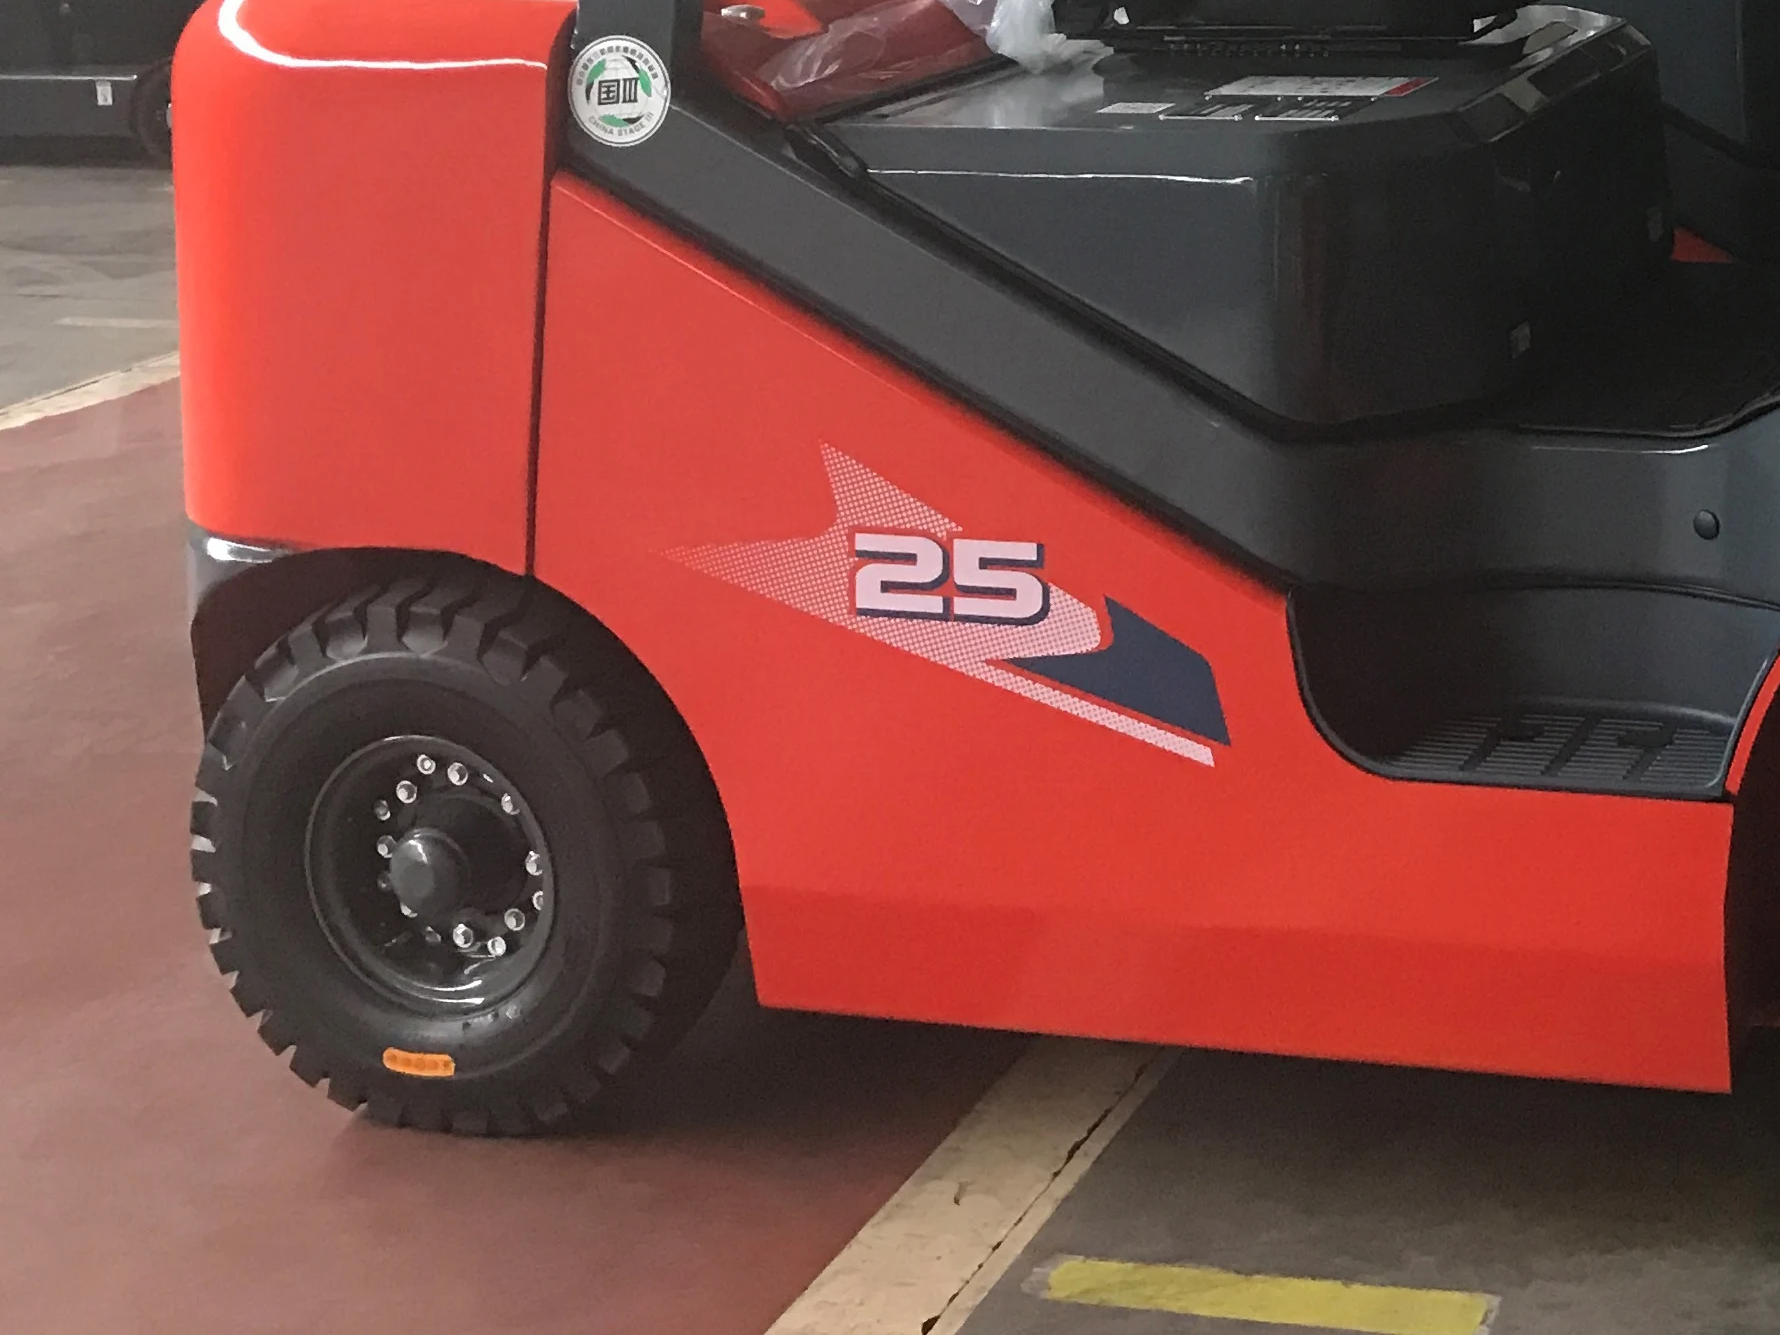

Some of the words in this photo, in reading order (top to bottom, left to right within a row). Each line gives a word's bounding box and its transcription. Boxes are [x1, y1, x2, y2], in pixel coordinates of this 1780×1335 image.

[588, 115, 614, 136] CHINA
[617, 123, 646, 137] STAGE
[855, 533, 1050, 626] 25
